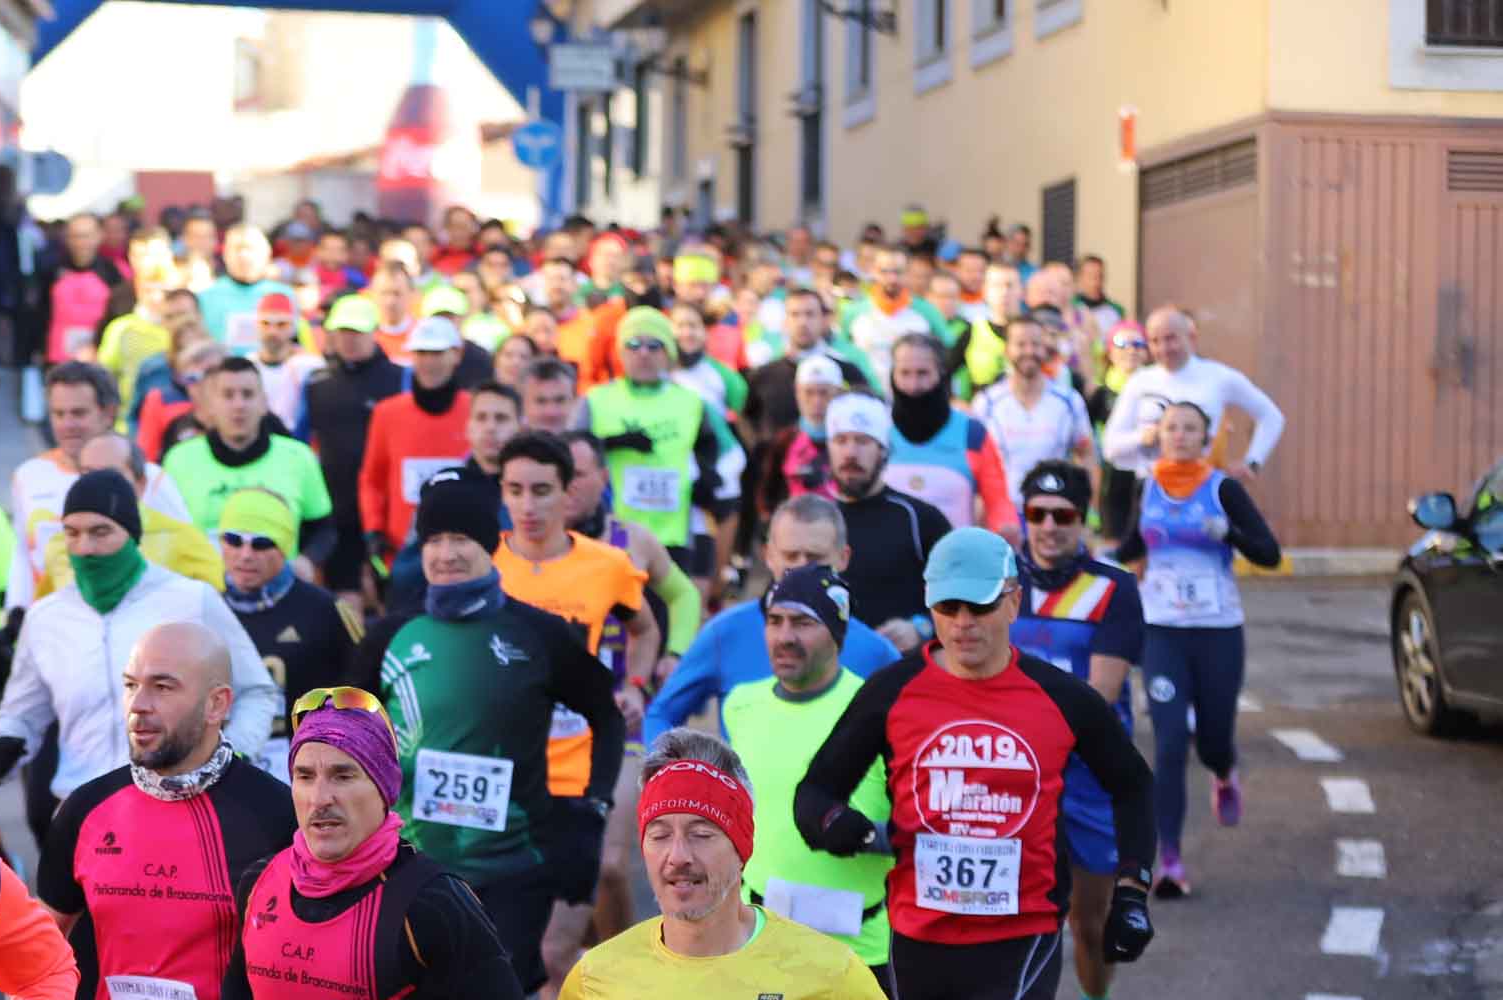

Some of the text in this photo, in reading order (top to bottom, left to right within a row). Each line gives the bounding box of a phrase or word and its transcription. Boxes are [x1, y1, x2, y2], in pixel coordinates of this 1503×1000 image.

[939, 734, 1017, 761] 2019
[434, 771, 488, 803] 259
[936, 855, 998, 889] 367
[149, 885, 164, 898] de
[284, 966, 298, 983] de
